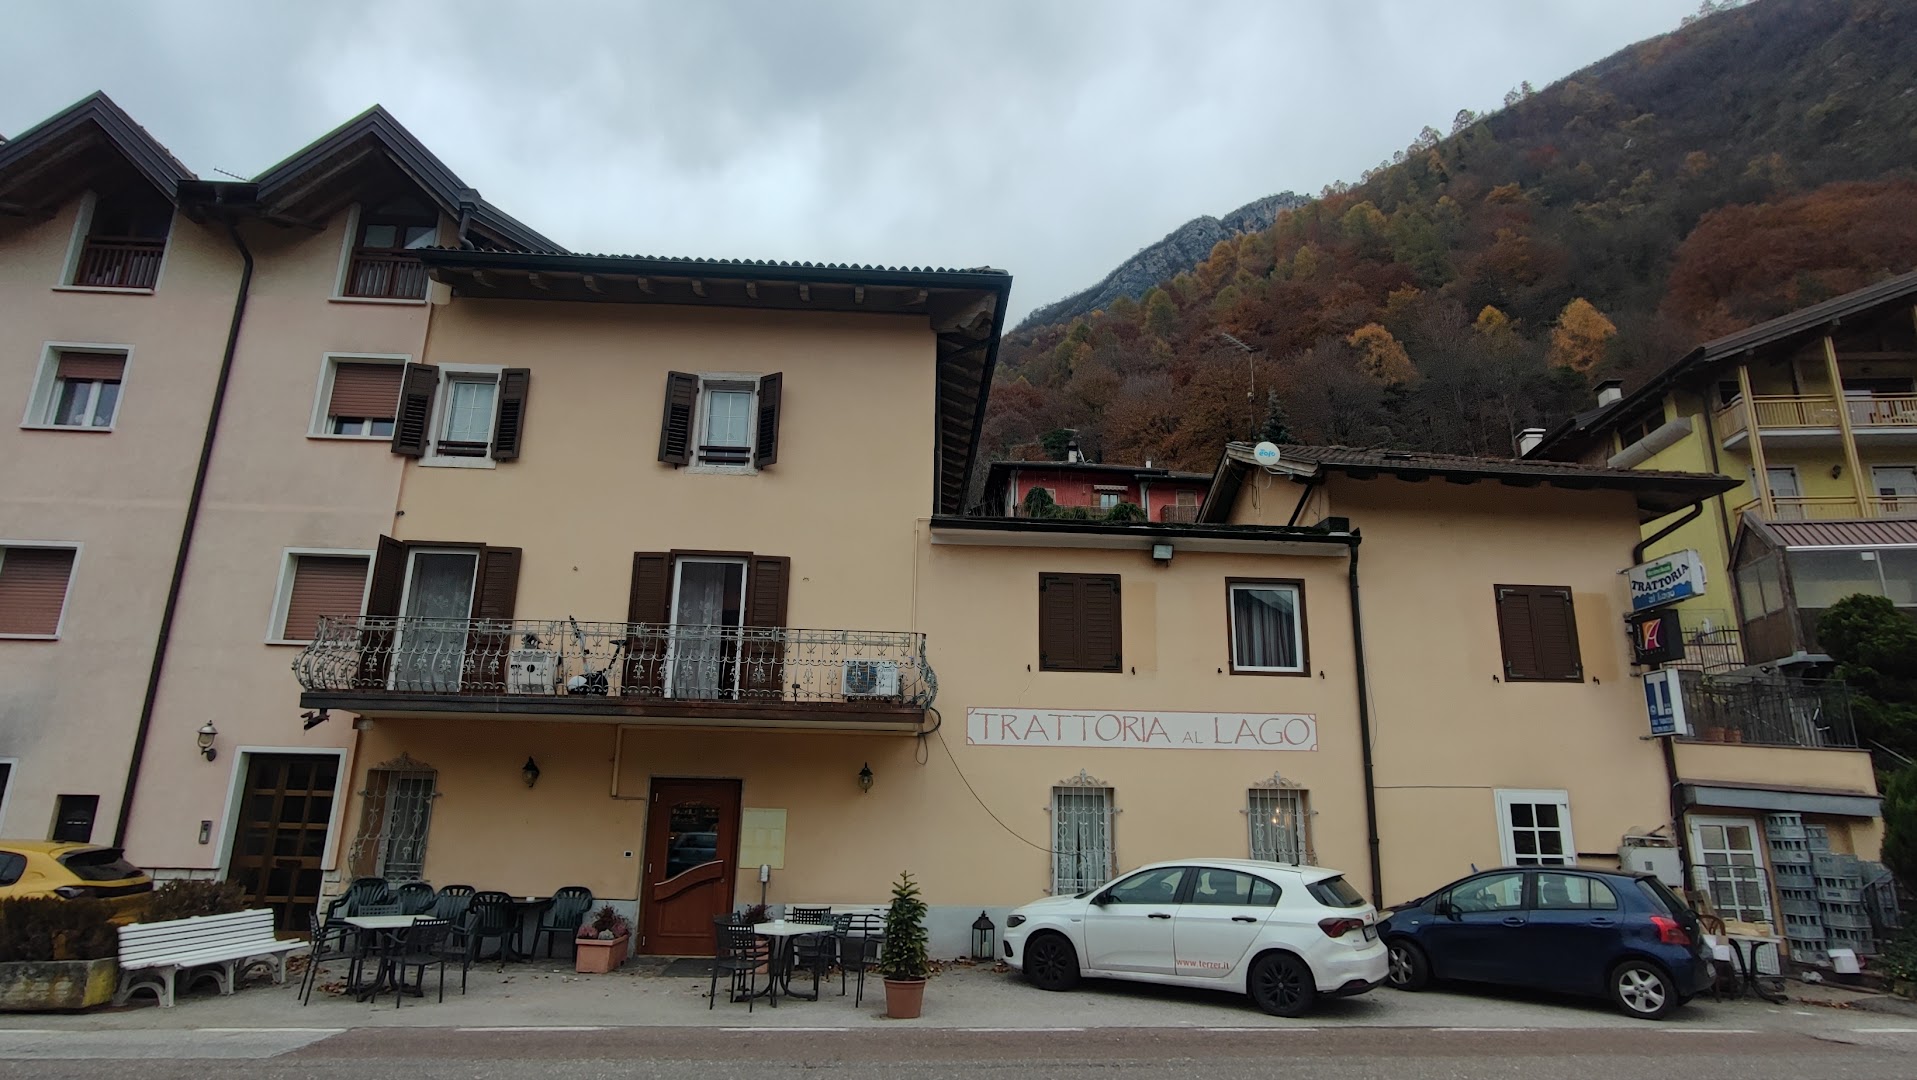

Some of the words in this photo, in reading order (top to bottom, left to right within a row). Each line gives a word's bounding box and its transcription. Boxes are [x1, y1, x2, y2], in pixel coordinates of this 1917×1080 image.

[1631, 563, 1689, 592] TRATTORIA
[974, 713, 1172, 744] TRATTORIA
[1182, 731, 1204, 744] AL
[1214, 716, 1311, 746] LAGO
[1176, 959, 1230, 970] www.terzer.it
